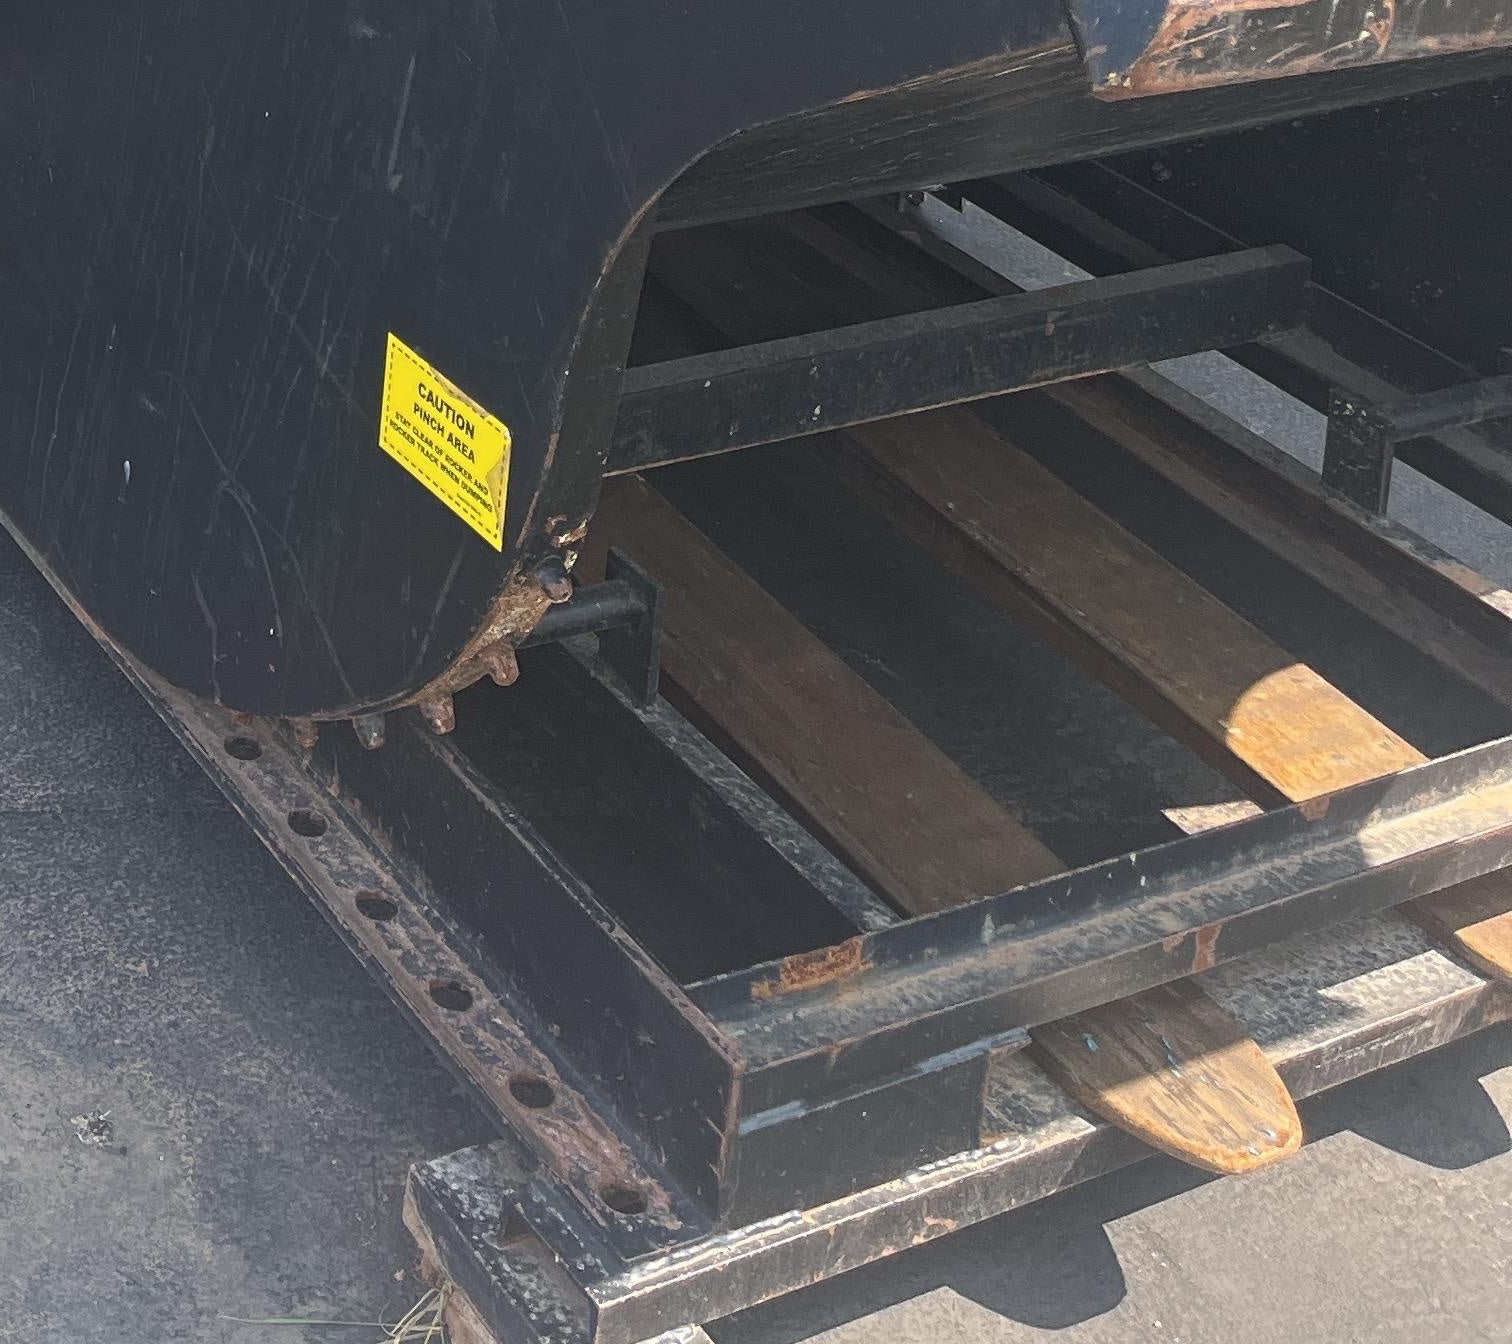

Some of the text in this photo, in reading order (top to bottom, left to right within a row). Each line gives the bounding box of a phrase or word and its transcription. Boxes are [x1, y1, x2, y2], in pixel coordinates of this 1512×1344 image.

[413, 402, 476, 464] PINCH AREA
[418, 382, 476, 440] CAUTION
[395, 411, 412, 428] STAY
[412, 426, 434, 448] CLEAR
[434, 443, 444, 456] OF
[473, 478, 489, 496] AND
[416, 440, 439, 467] TRACK
[440, 461, 461, 485] WHEN
[461, 480, 493, 514] DUMPING
